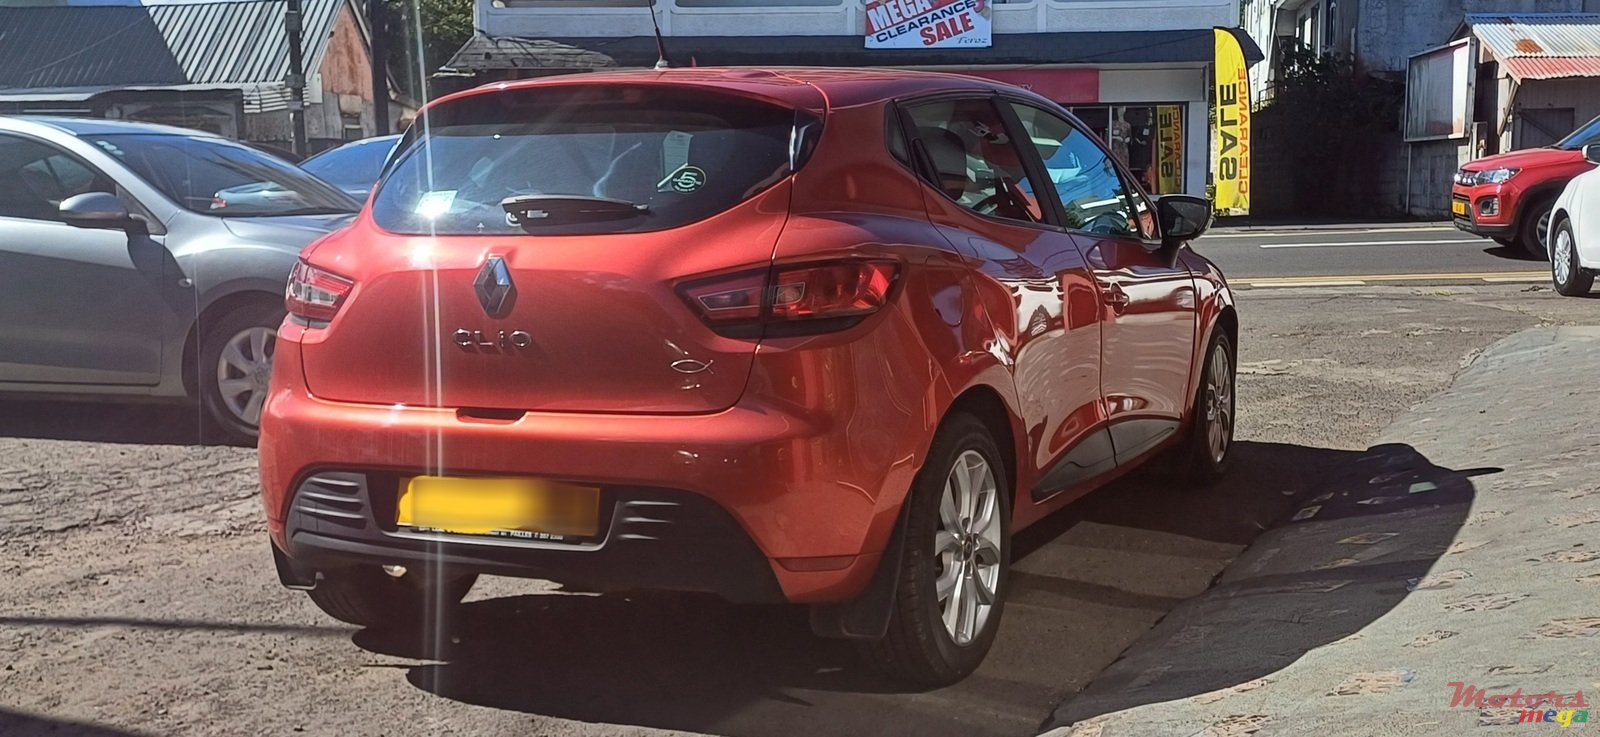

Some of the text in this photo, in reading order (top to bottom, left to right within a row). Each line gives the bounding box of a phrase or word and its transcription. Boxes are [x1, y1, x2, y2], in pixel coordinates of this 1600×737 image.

[867, 0, 932, 32] MEGA
[876, 0, 976, 42] CLEARANCE
[920, 12, 974, 46] SALE
[680, 171, 697, 188] 5
